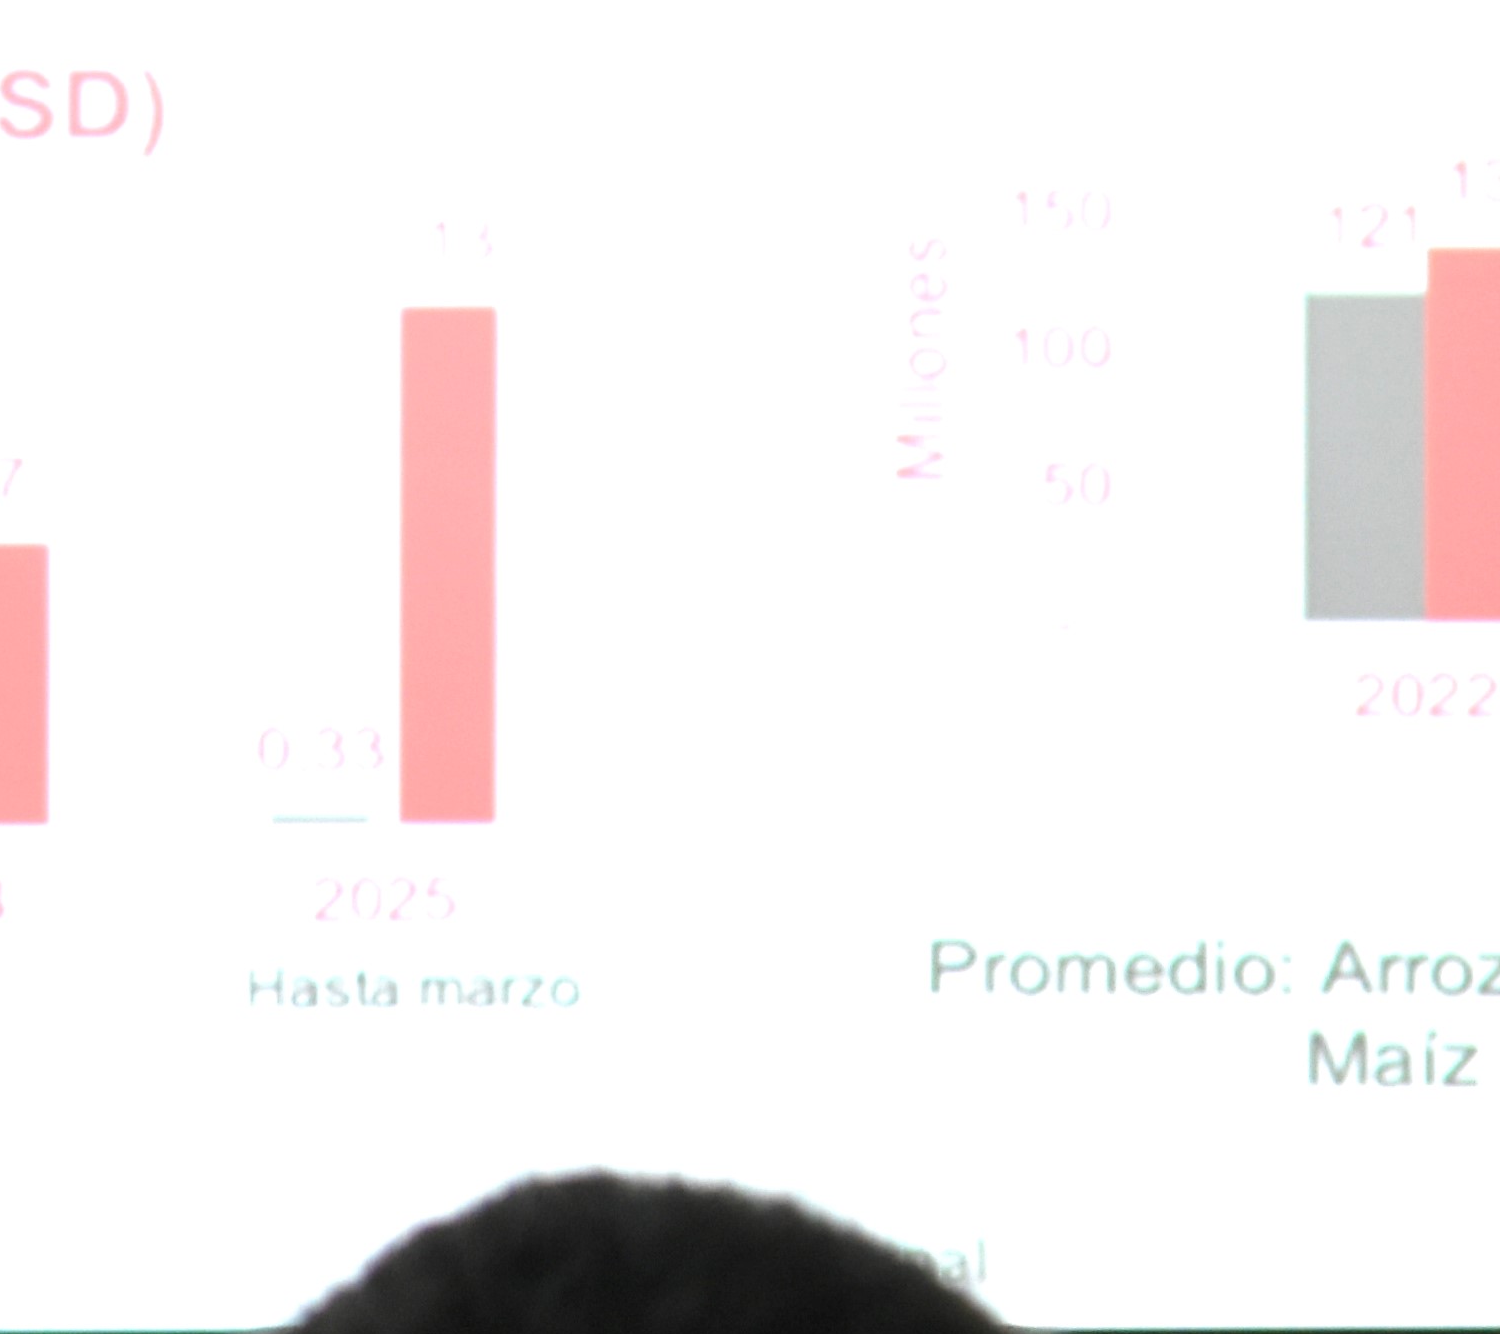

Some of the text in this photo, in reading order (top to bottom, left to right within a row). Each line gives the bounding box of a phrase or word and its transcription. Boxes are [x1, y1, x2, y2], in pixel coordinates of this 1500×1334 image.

[1332, 205, 1416, 249] 121
[1015, 328, 1112, 368] 100
[1044, 463, 1112, 504] 50
[257, 727, 385, 769] 033
[314, 877, 456, 922] 2025
[249, 969, 581, 1008] Hasta marzo
[930, 938, 1291, 996] Promedio:
[1308, 1029, 1478, 1087] Maíz
